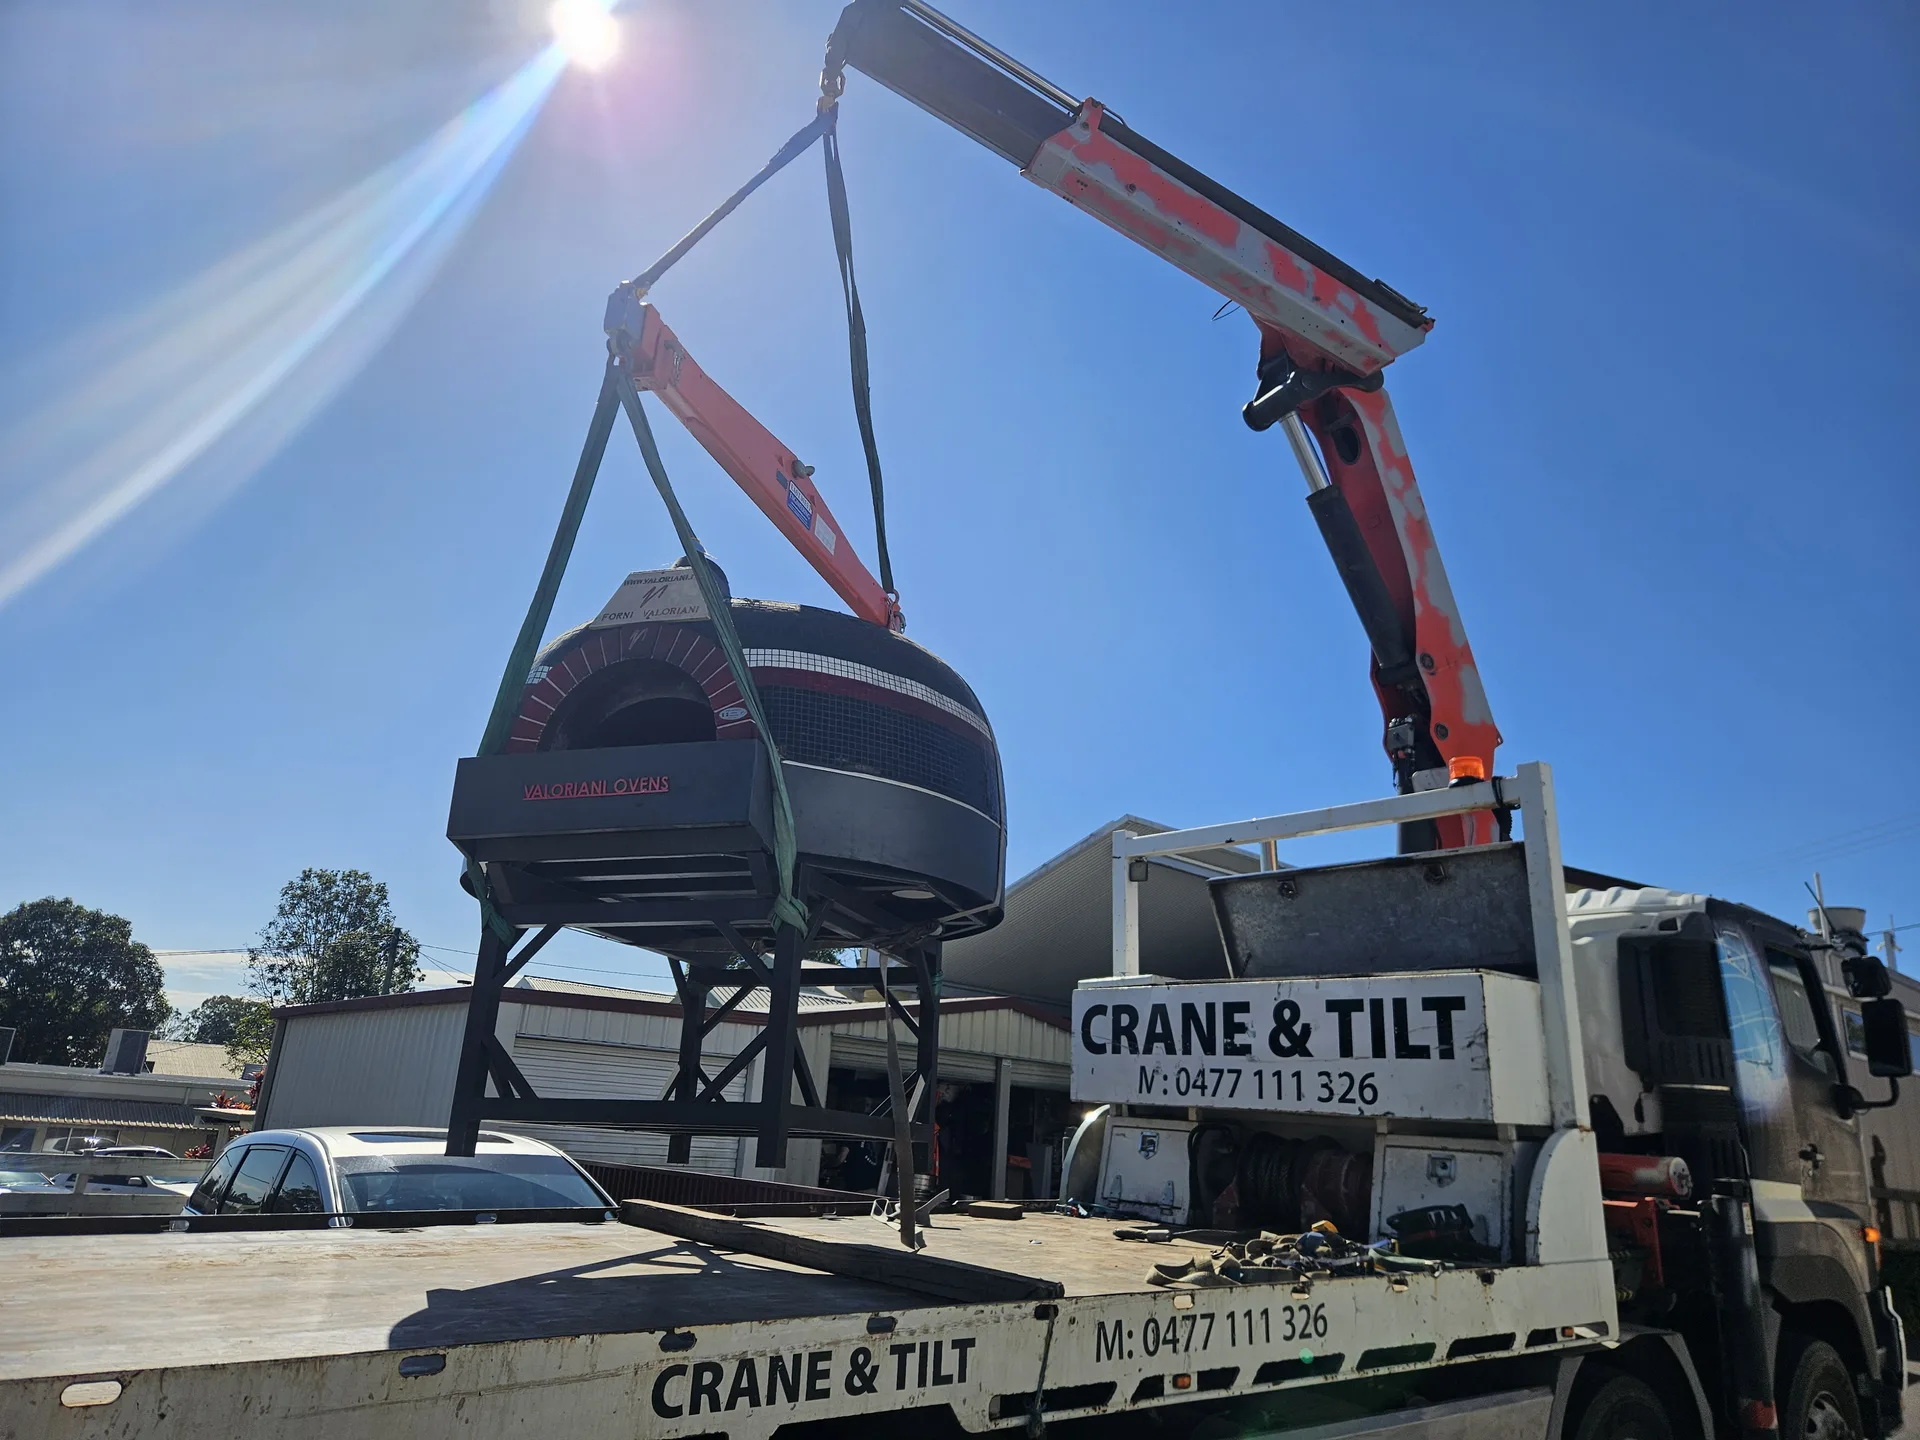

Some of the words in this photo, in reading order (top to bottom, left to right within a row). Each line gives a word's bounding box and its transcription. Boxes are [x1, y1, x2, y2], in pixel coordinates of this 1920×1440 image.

[601, 611, 634, 622] FORNI
[643, 605, 700, 618] VALORIANI
[523, 780, 607, 799] VALORIANI
[614, 776, 669, 793] OVENS
[1081, 1001, 1252, 1057] CRANE
[1268, 999, 1314, 1058] &
[1325, 996, 1467, 1060] TILT
[1175, 1067, 1243, 1098] 0477
[1253, 1069, 1302, 1101] 111
[1317, 1071, 1379, 1105] 326
[1095, 1319, 1133, 1363] M:
[1143, 1312, 1216, 1357] 0477
[1226, 1307, 1270, 1347] 111
[1282, 1303, 1328, 1342] 326
[651, 1350, 832, 1419] CRANE
[844, 1346, 879, 1396] &
[889, 1337, 976, 1391] TILT
